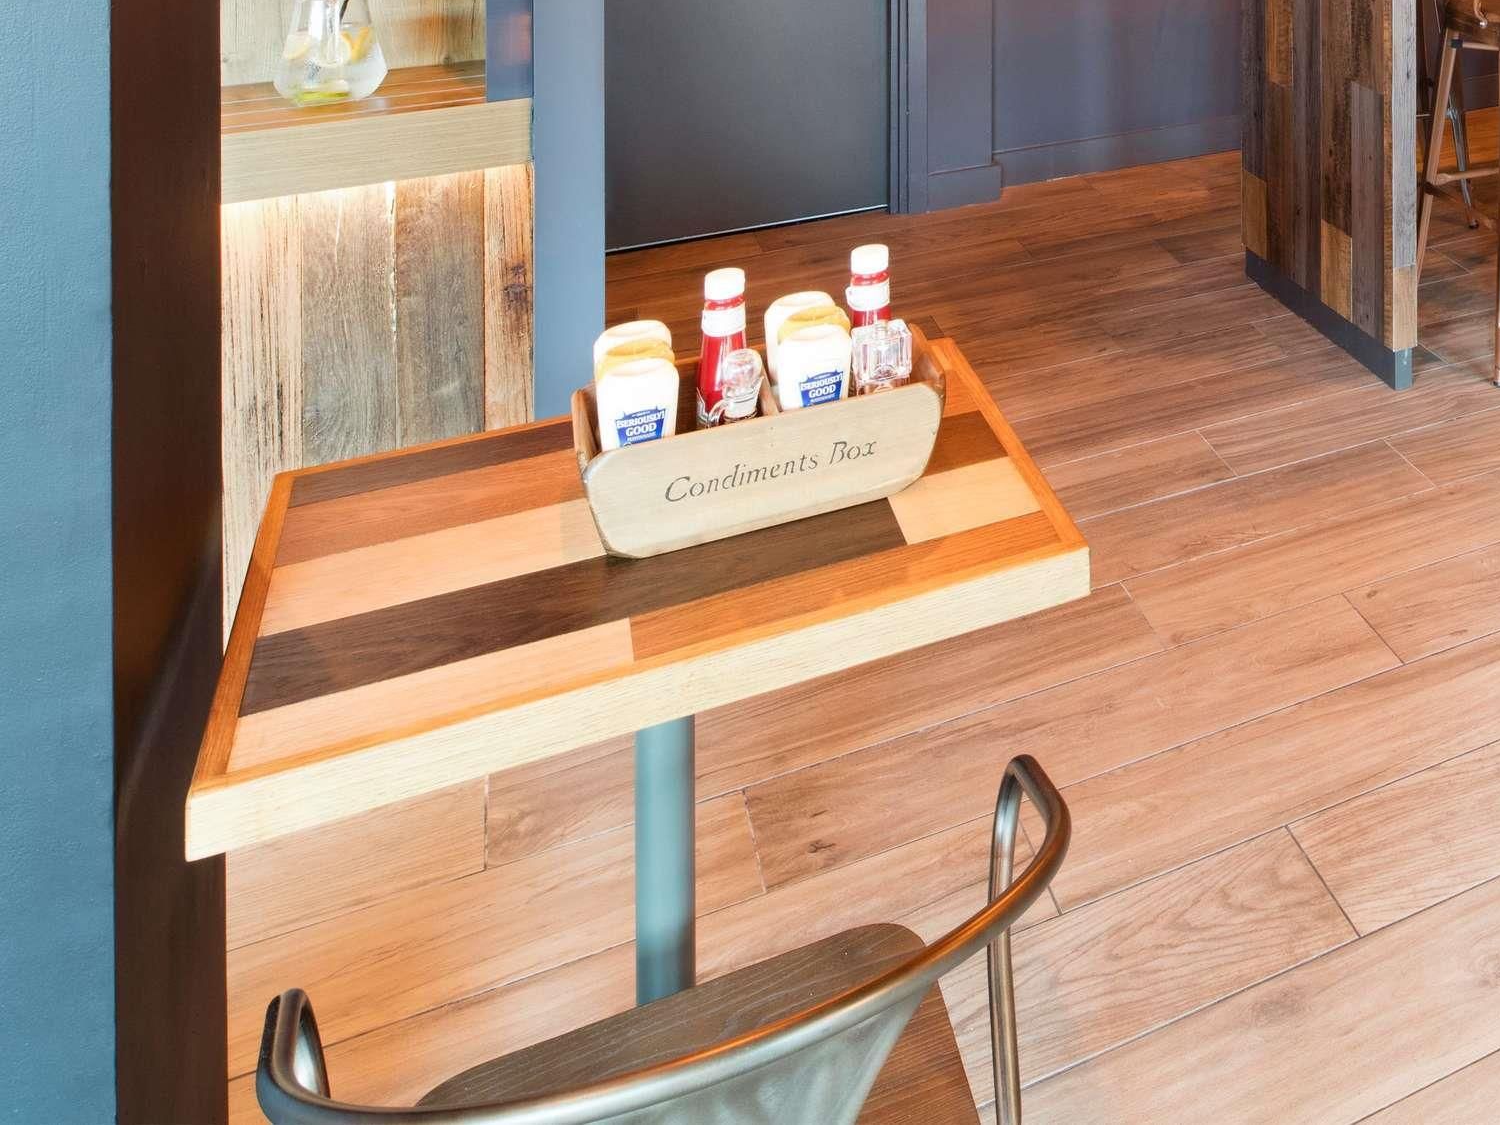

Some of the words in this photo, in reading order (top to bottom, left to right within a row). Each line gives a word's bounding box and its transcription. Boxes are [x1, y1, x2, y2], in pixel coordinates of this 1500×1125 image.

[808, 384, 837, 398] GOOD
[625, 422, 657, 437] GOOD
[664, 450, 819, 503] Condiments
[829, 439, 878, 466] Box
